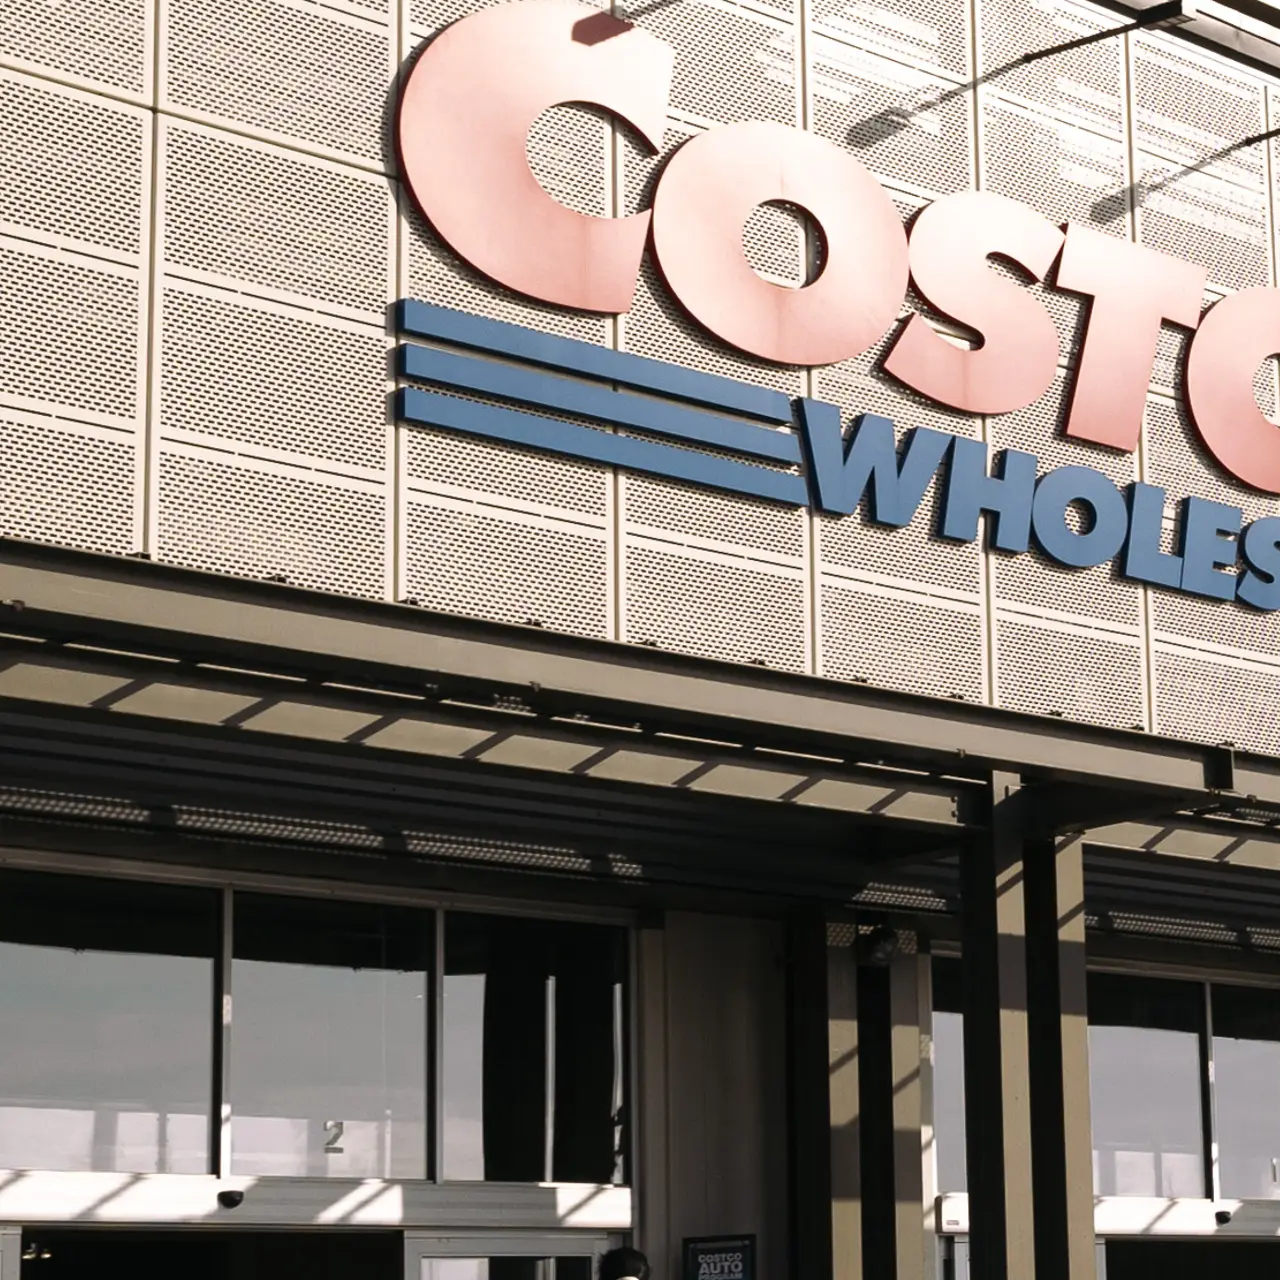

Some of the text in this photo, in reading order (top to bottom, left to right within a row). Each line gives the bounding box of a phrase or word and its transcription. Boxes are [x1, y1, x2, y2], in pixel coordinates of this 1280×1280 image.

[323, 1121, 344, 1154] 2
[698, 1252, 743, 1263] COSTCO
[699, 1261, 743, 1274] AUTO
[698, 1272, 743, 1280] PROGRAM
